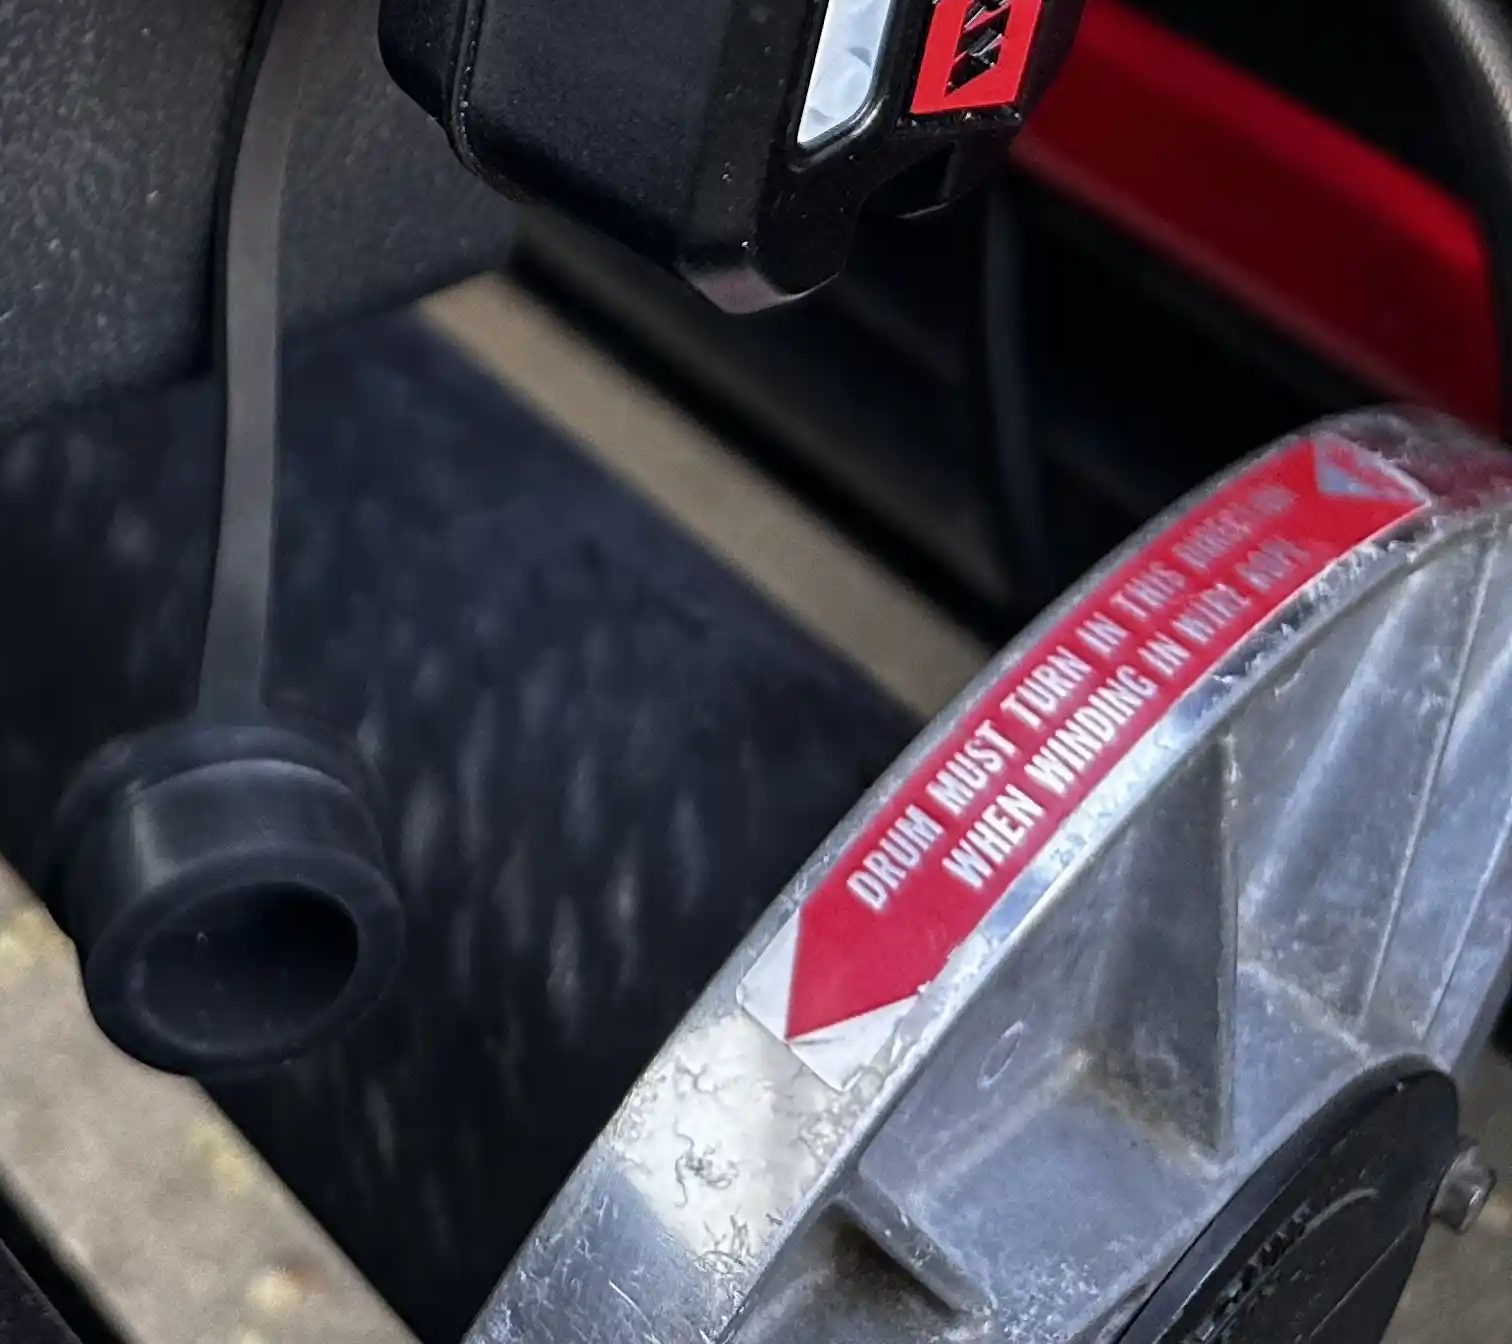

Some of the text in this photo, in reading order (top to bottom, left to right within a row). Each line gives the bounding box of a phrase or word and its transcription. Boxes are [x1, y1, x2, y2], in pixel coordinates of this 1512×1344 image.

[846, 803, 944, 911] DRUM
[925, 719, 1018, 817] MUST
[1000, 644, 1094, 729] TURN
[1075, 611, 1129, 658] IN
[1110, 561, 1186, 621] THIS
[941, 783, 1045, 890] WHEN
[1023, 664, 1159, 797] WINDING
[1137, 631, 1190, 678] IN
[1170, 582, 1253, 645] WIRE
